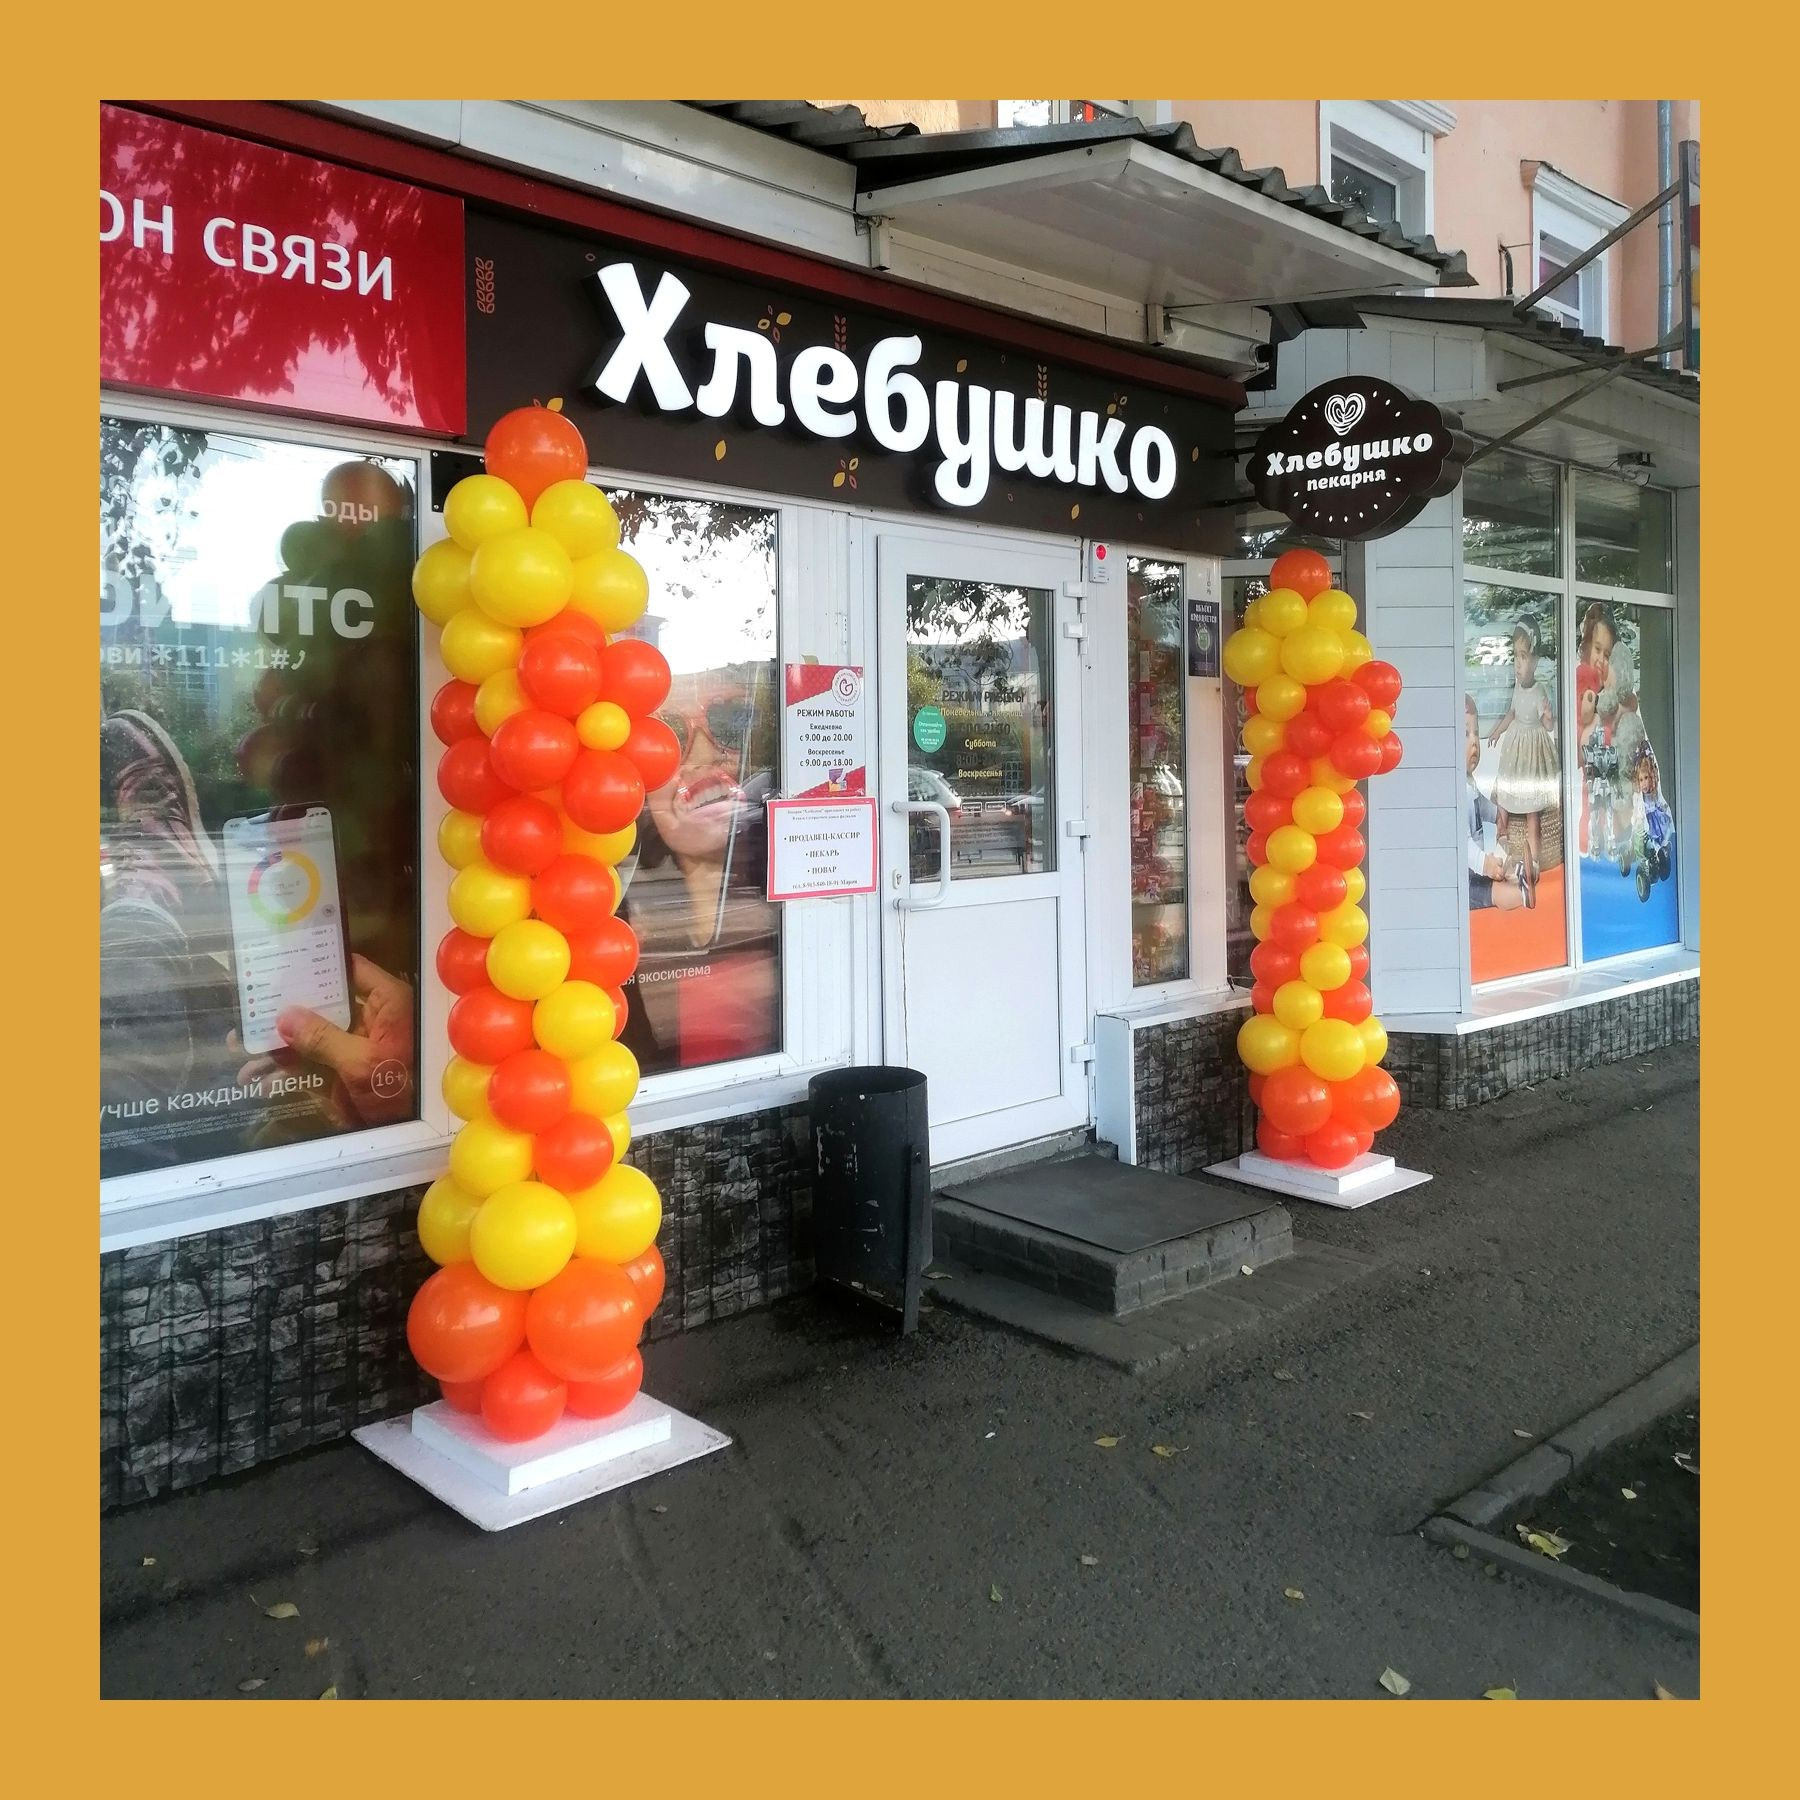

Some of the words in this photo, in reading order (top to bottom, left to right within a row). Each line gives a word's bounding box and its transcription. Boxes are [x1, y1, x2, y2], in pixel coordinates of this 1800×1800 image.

[203, 217, 393, 301] СВЯЗИ
[595, 262, 1177, 507] Хлебушко
[1266, 433, 1433, 477] Хлебушко
[1306, 469, 1387, 492] пекарня
[322, 500, 379, 525] оды
[796, 709, 825, 718] РЕЖИМ
[825, 709, 855, 718] РАБОТЫ
[809, 723, 843, 731] Ежедневно
[804, 733, 821, 742] 9.00
[821, 735, 832, 743] до
[833, 733, 853, 742] 20.00
[964, 738, 997, 750] Суббота
[807, 748, 845, 756] Воскресенье
[805, 758, 821, 767] 9.00
[822, 760, 832, 768] до
[834, 758, 853, 767] 18.00
[958, 768, 1003, 780] Воскресенья
[789, 831, 861, 843] ПРОДАВЕЦ-КАССИР
[809, 849, 840, 858] ПЕКАРЬ
[812, 865, 837, 875] ПОВАР
[638, 965, 711, 984] экосистема
[375, 1071, 405, 1087] 16+
[168, 1077, 263, 1112] каждый
[269, 1070, 324, 1100] день
